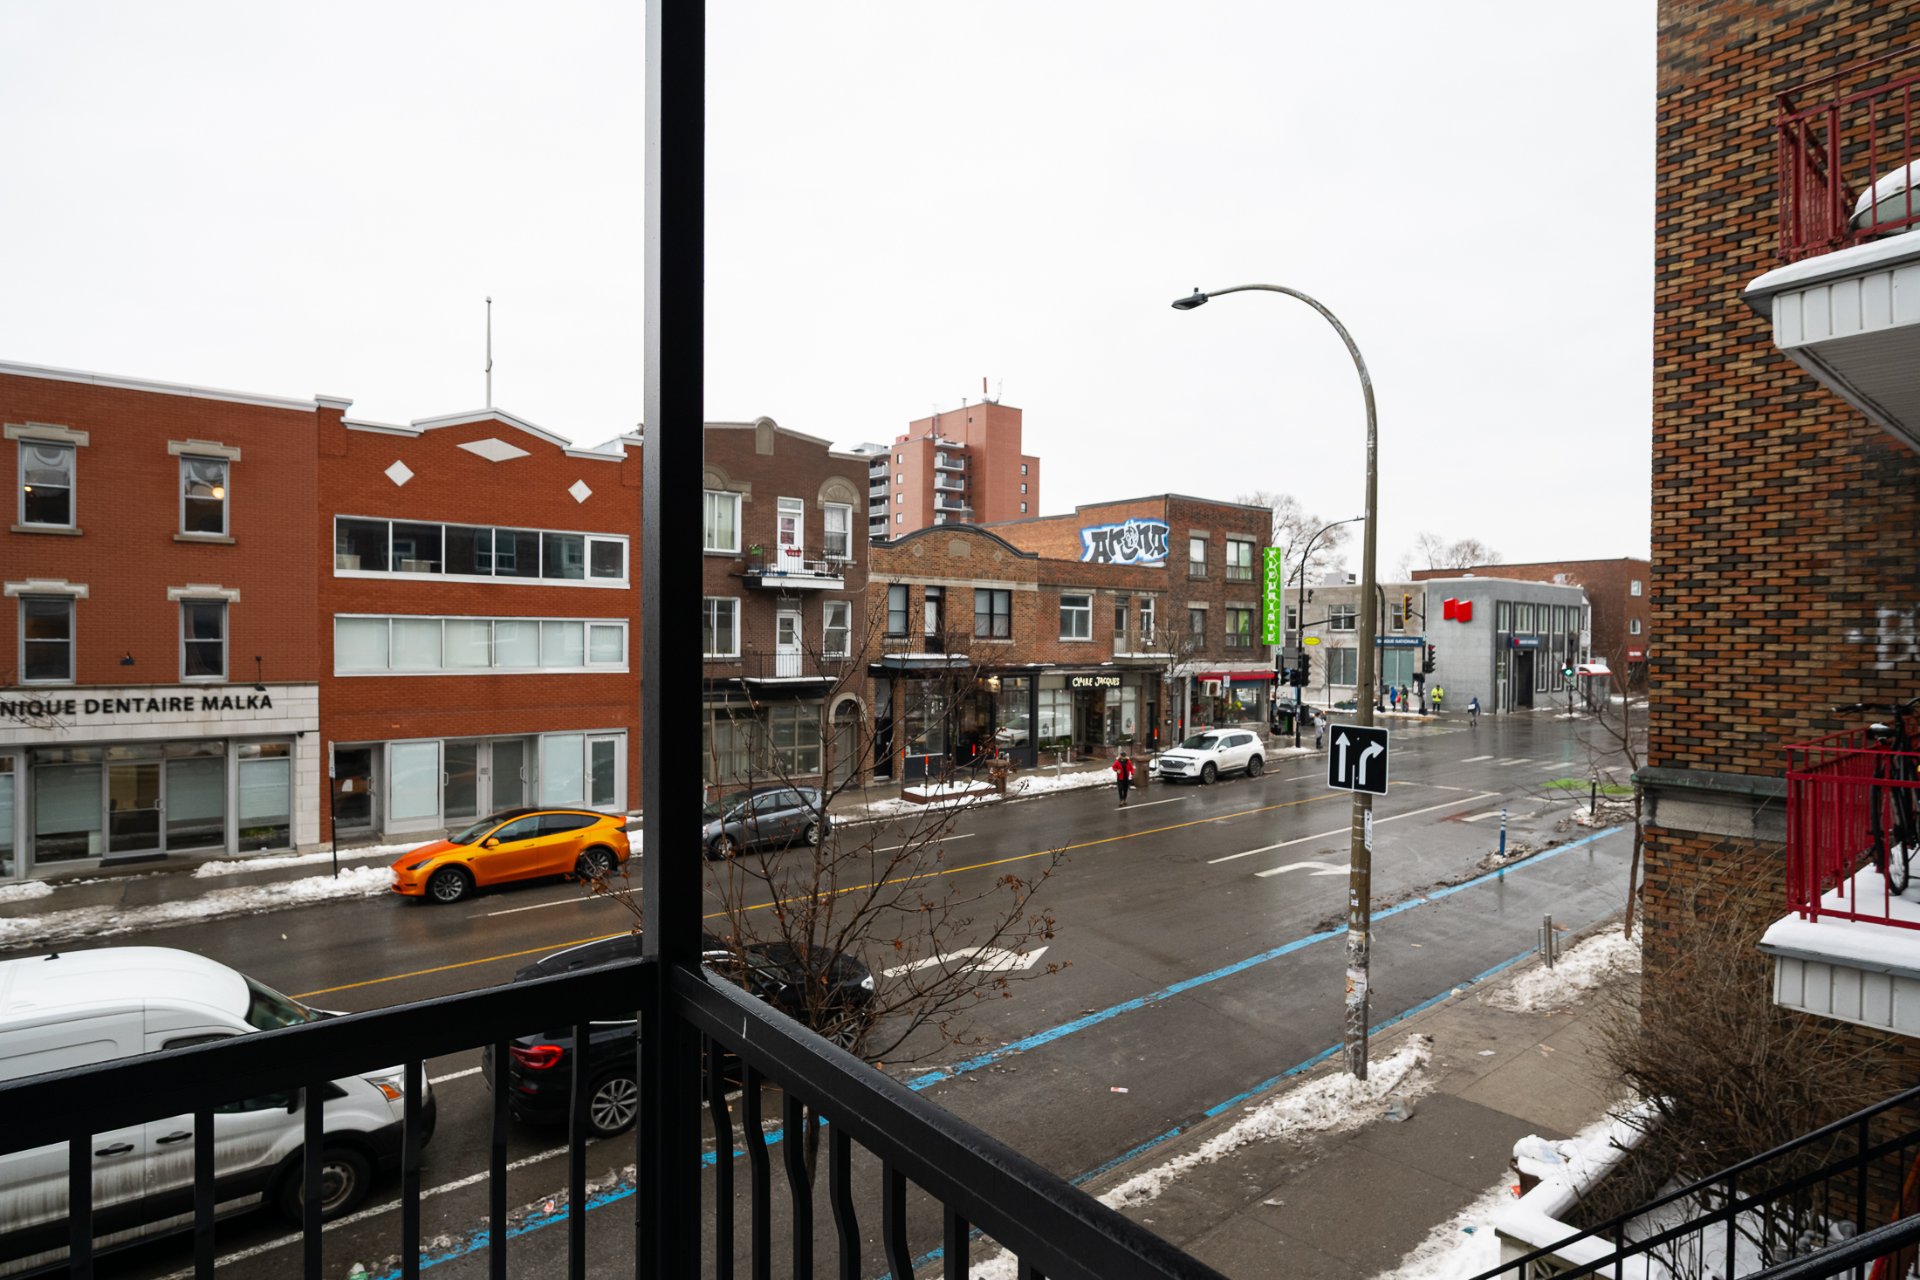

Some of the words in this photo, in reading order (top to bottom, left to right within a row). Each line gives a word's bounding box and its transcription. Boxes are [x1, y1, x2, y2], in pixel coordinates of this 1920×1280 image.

[1267, 549, 1277, 642] FLEURISTE
[1095, 676, 1120, 687] JACQUES
[84, 697, 195, 714] DENTAIRE
[202, 695, 272, 711] MALKA
